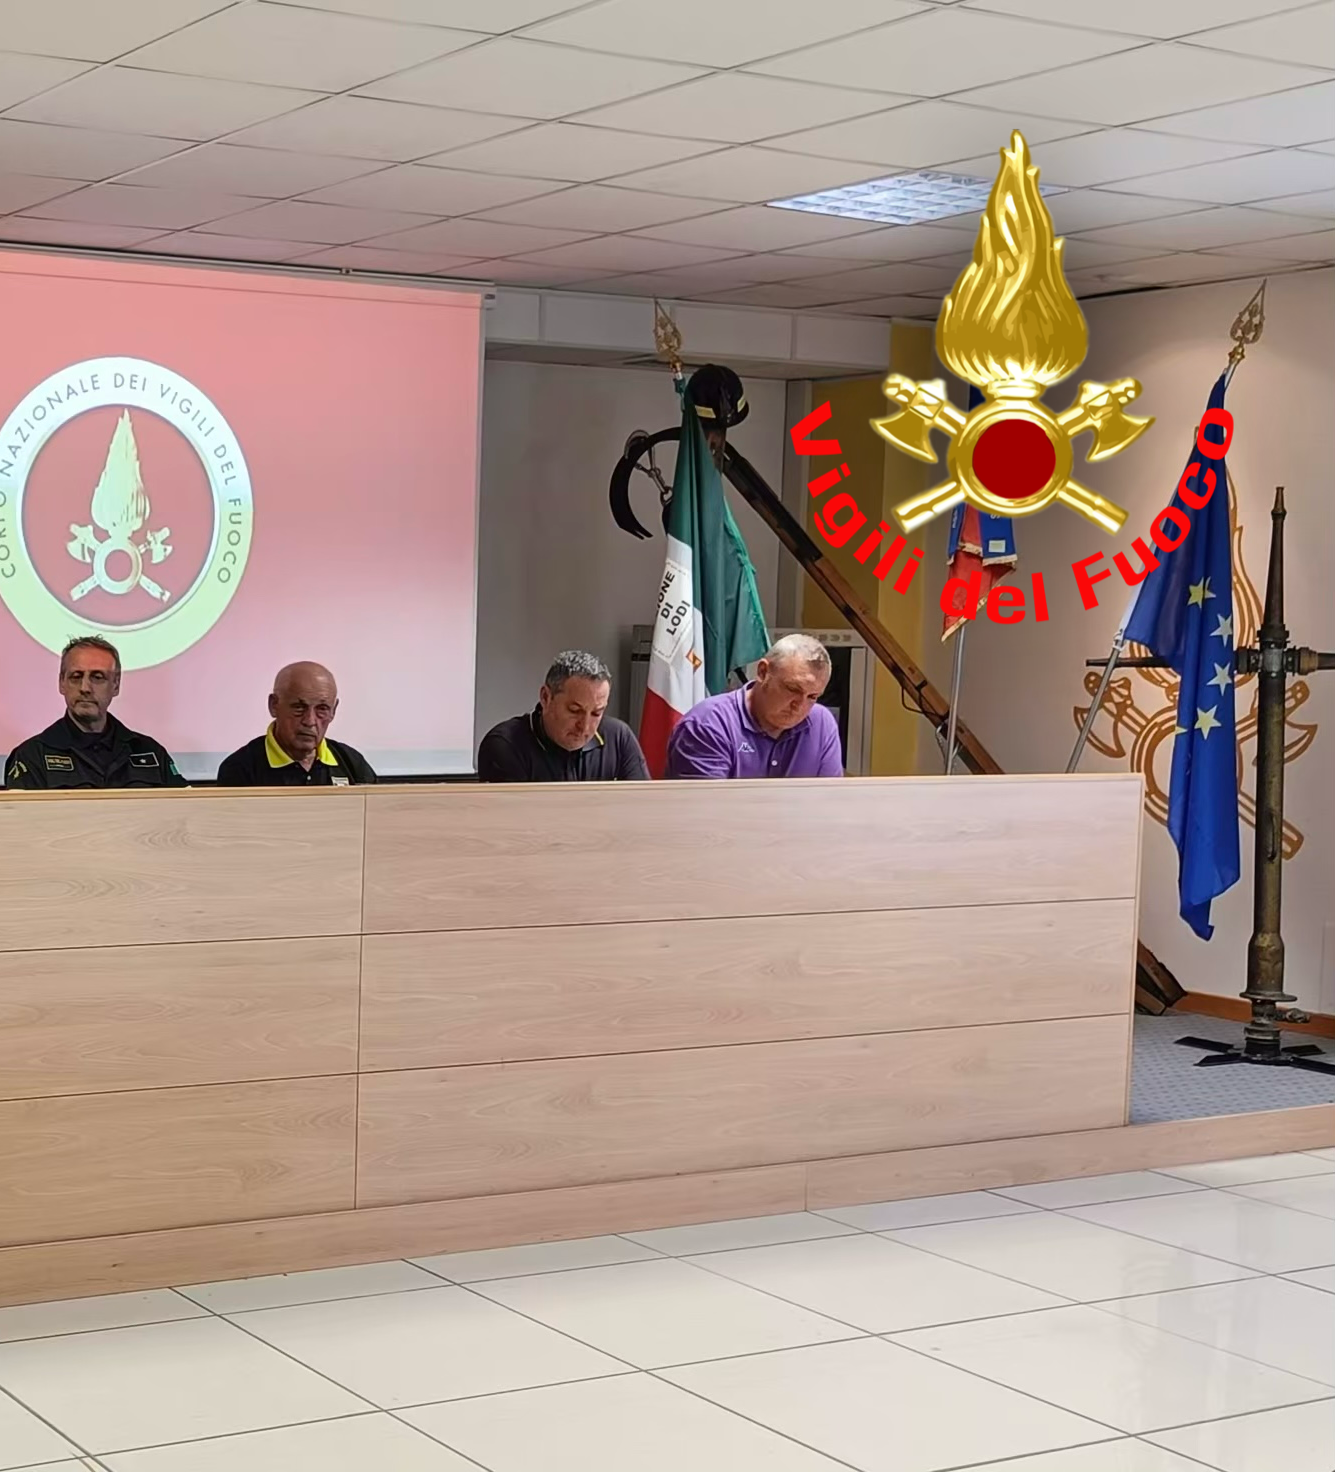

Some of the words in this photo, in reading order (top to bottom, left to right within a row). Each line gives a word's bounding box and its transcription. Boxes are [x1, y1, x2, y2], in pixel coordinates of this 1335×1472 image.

[113, 373, 147, 392] DEI
[160, 384, 214, 437] VIGILI
[214, 444, 237, 486] DEL
[217, 497, 242, 583] FUOCO
[660, 602, 674, 619] DI
[666, 600, 690, 636] LODI
